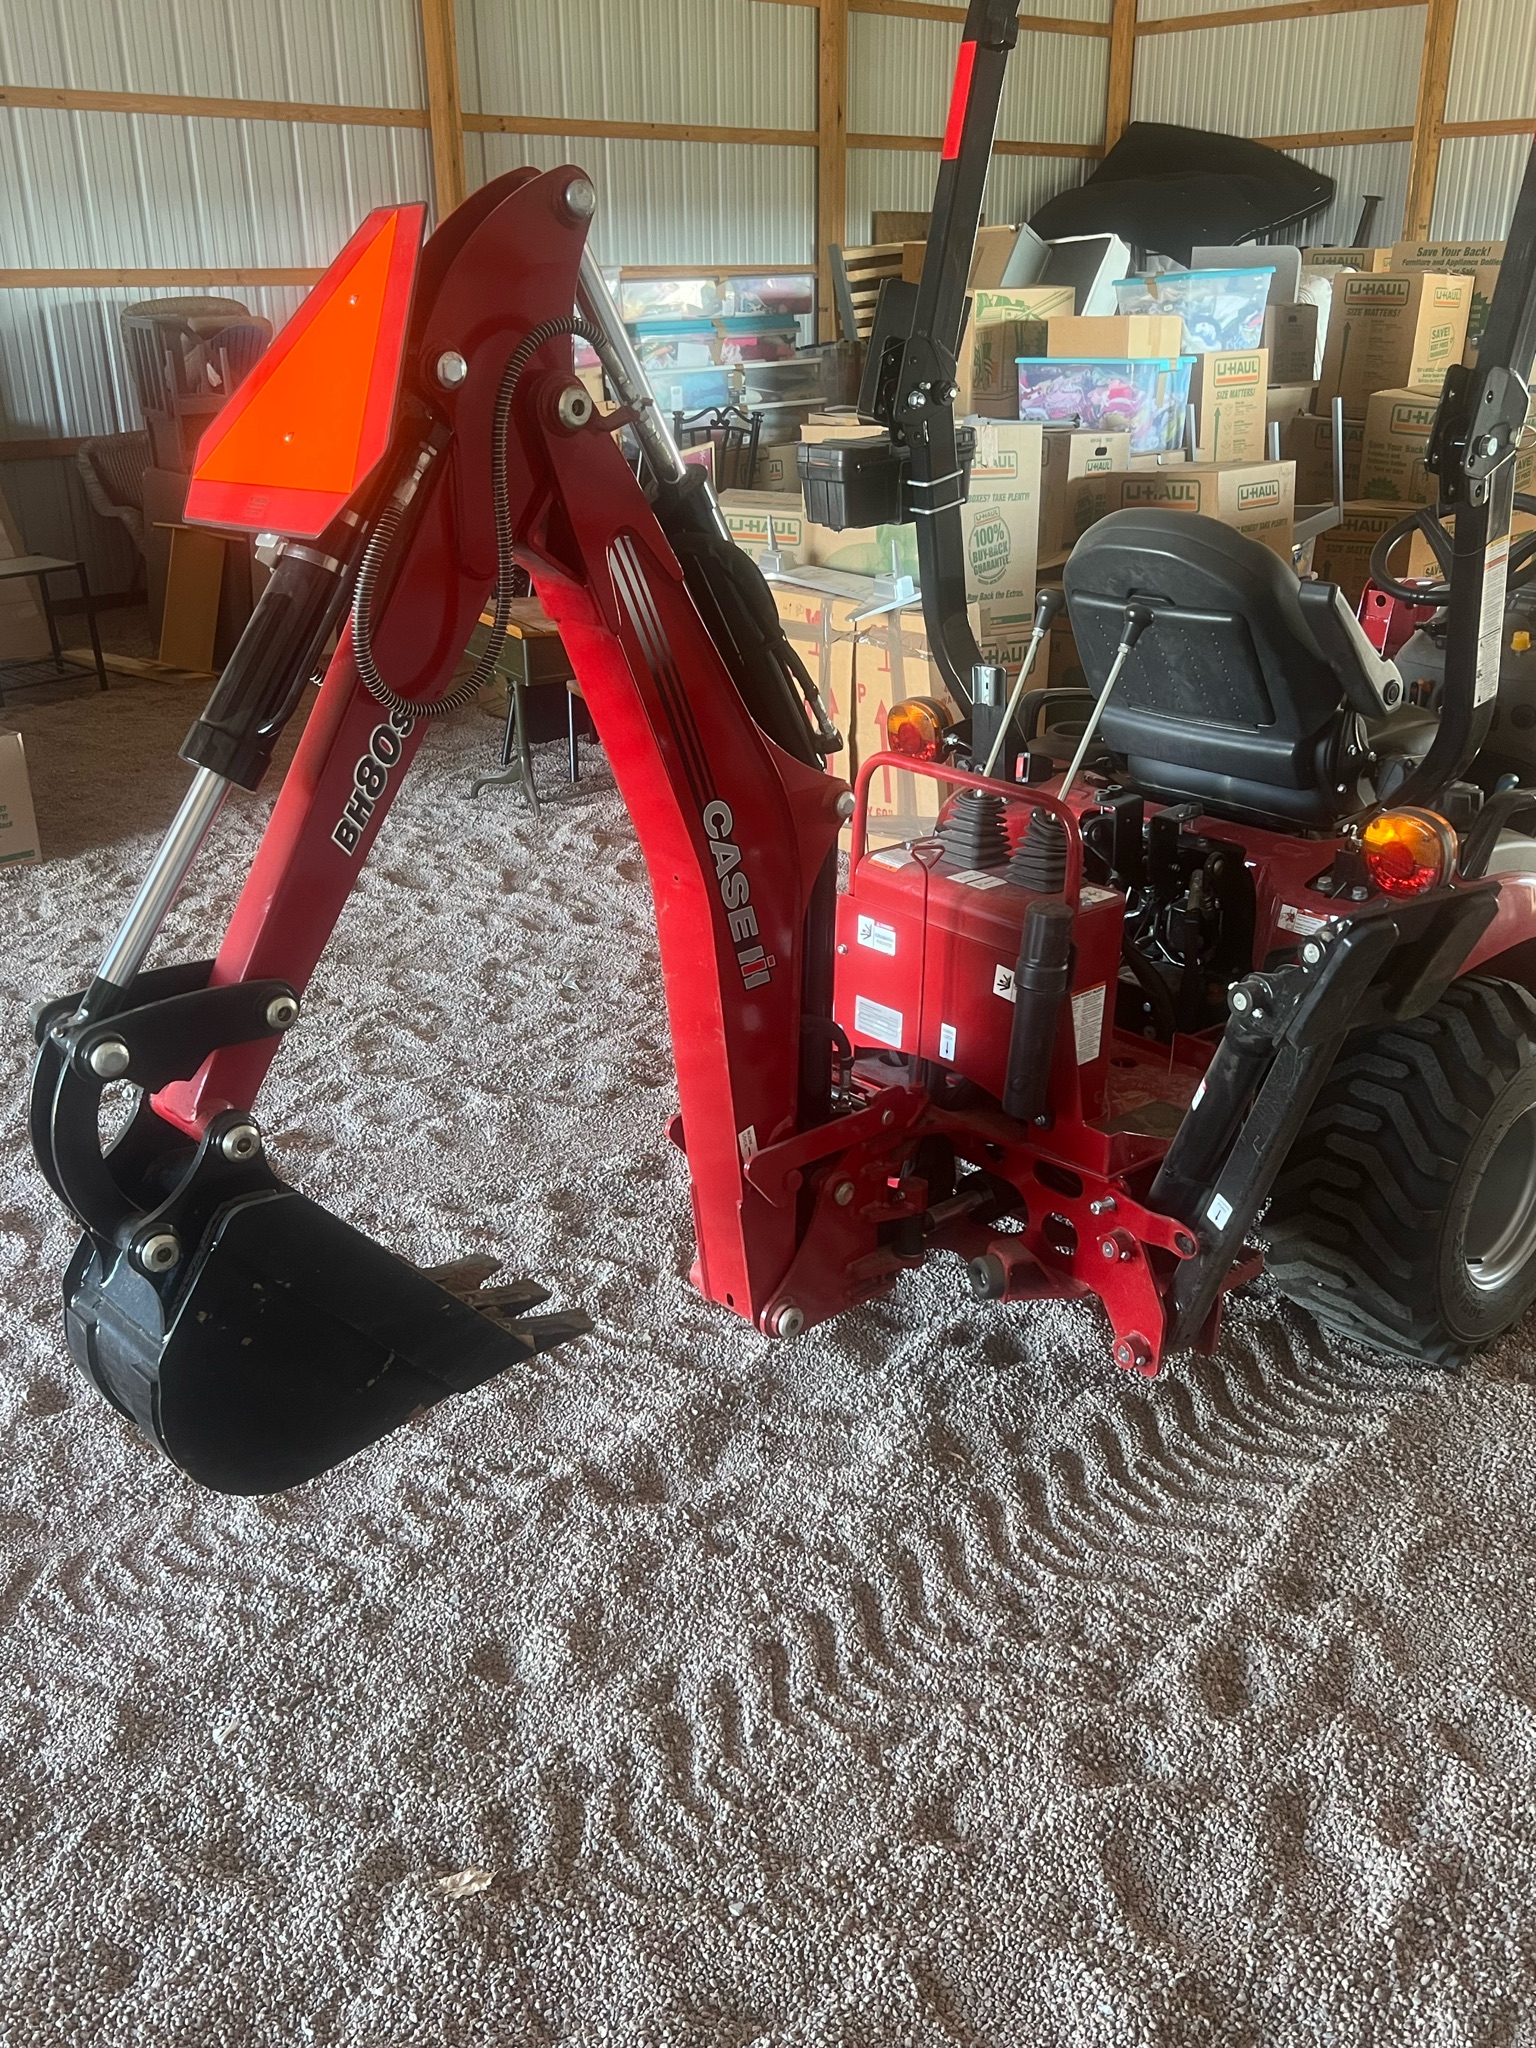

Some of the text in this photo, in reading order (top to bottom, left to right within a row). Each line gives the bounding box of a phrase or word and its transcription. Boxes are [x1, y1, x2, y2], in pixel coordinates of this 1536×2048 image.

[1416, 246, 1491, 257] Save Your Back!
[1445, 259, 1478, 267] Appliance
[1350, 283, 1405, 296] U-HAUL
[1436, 289, 1460, 300] U-HAUL
[1346, 308, 1401, 318] SIZE MATTERS!
[1431, 326, 1451, 340] SAVE!
[1217, 361, 1258, 376] U-HAUL
[1216, 388, 1255, 400] SIZE MATTERS!
[1087, 462, 1110, 472] U-HAUL
[992, 493, 1006, 502] TAKE
[1241, 484, 1277, 500] U-HAUL
[975, 509, 998, 521] U-HAUL
[974, 523, 1005, 548] 100%
[972, 541, 1008, 563] BUY-BACK
[979, 592, 994, 600] Back
[995, 591, 1005, 600] the
[1006, 589, 1024, 599] Extras.
[703, 800, 759, 942] CASE
